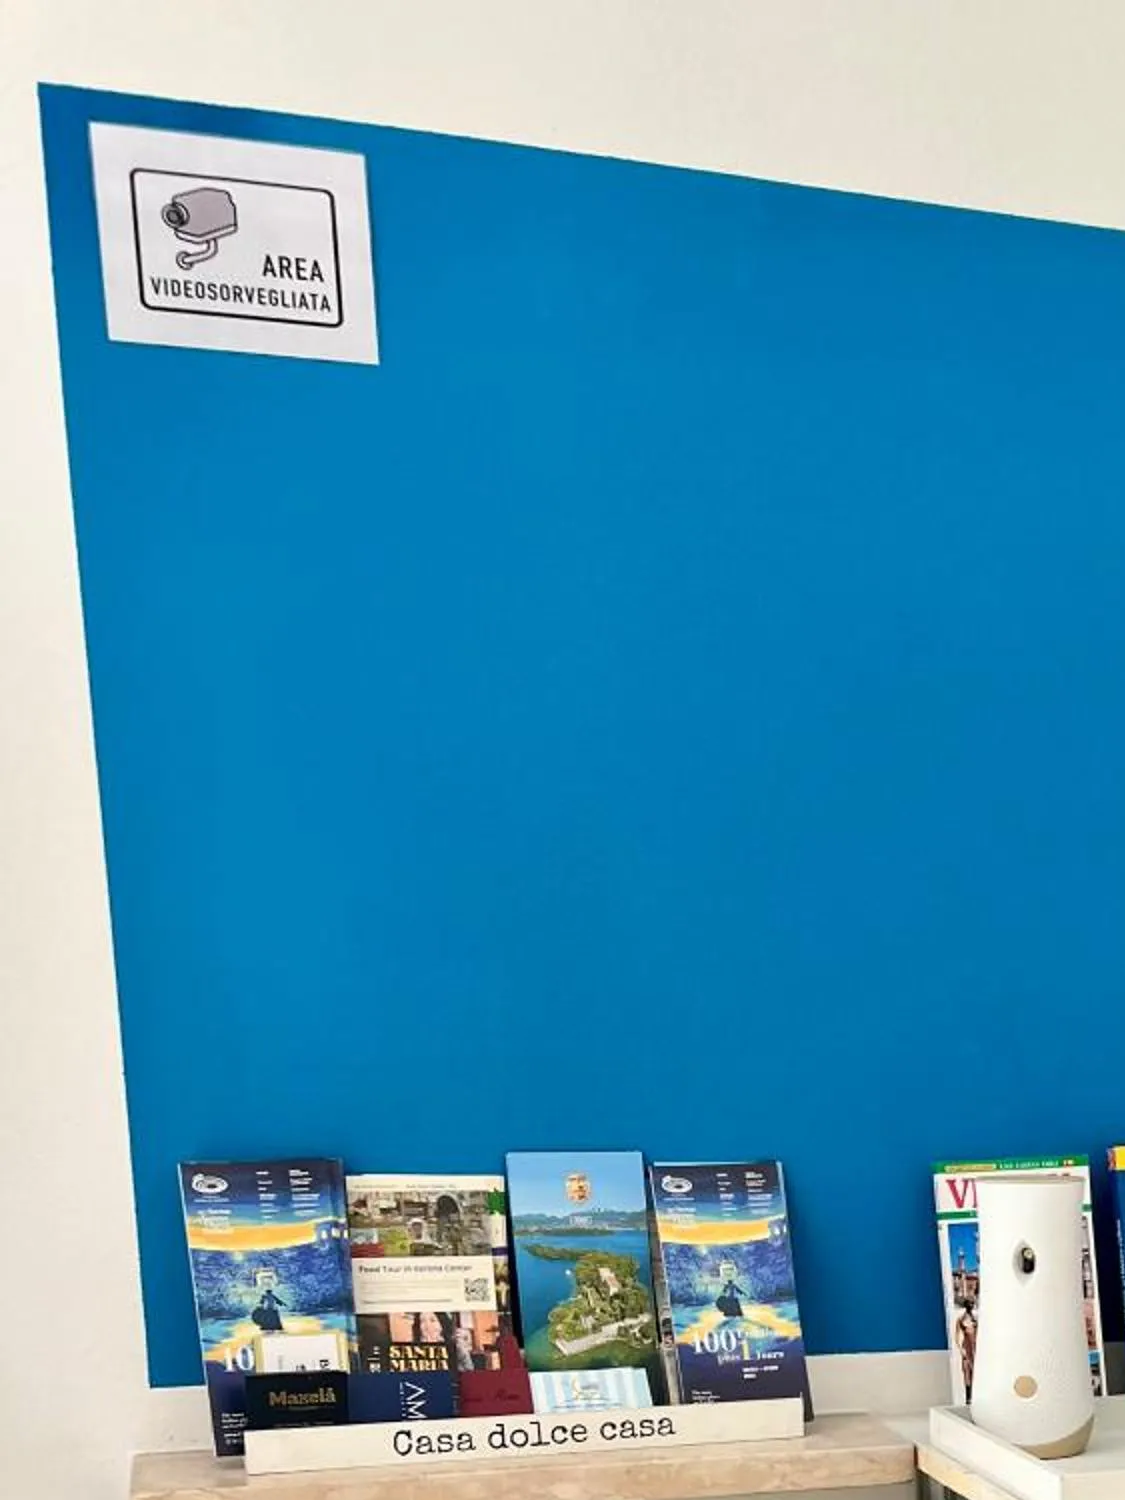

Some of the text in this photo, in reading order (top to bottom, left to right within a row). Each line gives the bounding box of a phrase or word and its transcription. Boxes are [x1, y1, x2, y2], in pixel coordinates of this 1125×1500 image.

[262, 254, 325, 283] AREA
[150, 277, 332, 313] VIDEOSORVEGLIATA
[388, 1345, 450, 1359] SANTA
[388, 1357, 450, 1373] MARIA
[393, 1415, 676, 1456] Casa dolce casa
